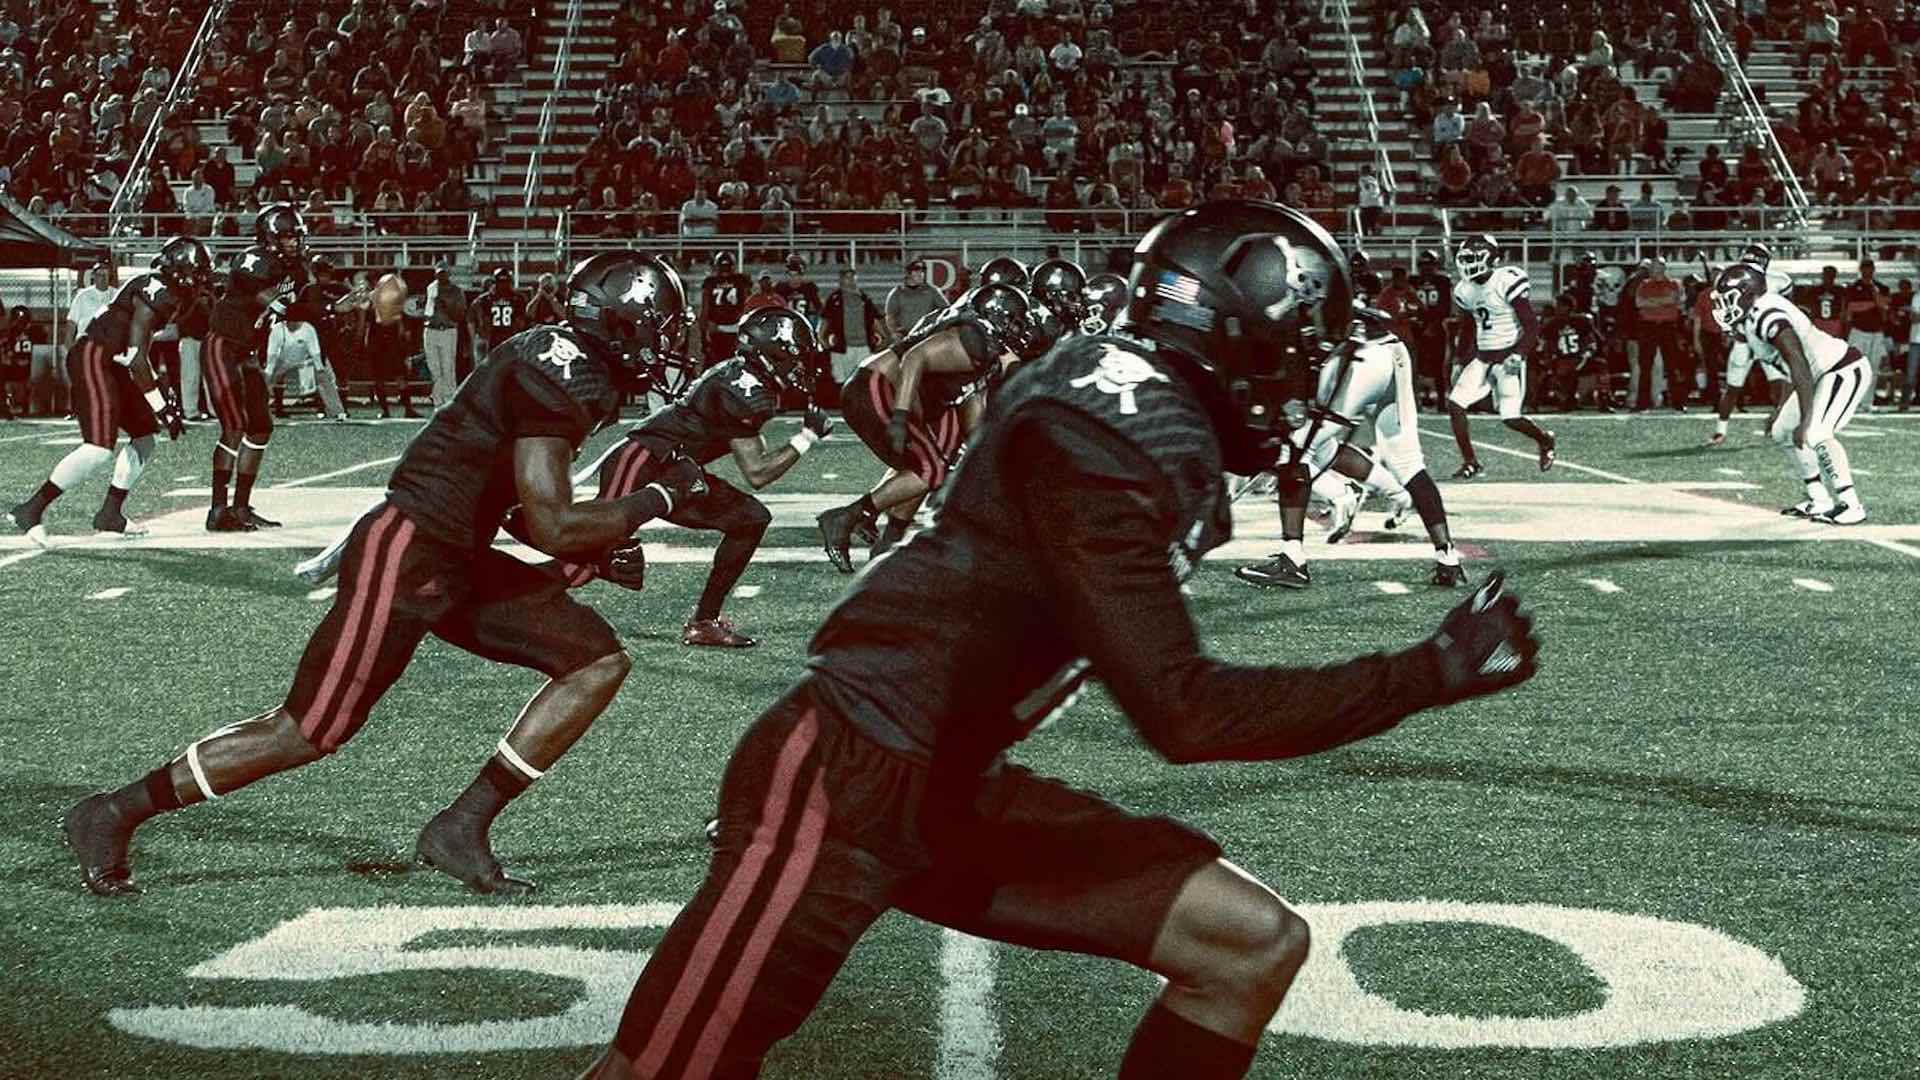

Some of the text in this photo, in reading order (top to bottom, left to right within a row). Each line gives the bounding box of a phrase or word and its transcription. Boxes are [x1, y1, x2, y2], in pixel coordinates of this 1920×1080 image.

[922, 259, 956, 290] D
[712, 288, 738, 305] 74
[491, 306, 512, 326] 28
[1476, 307, 1492, 330] 2
